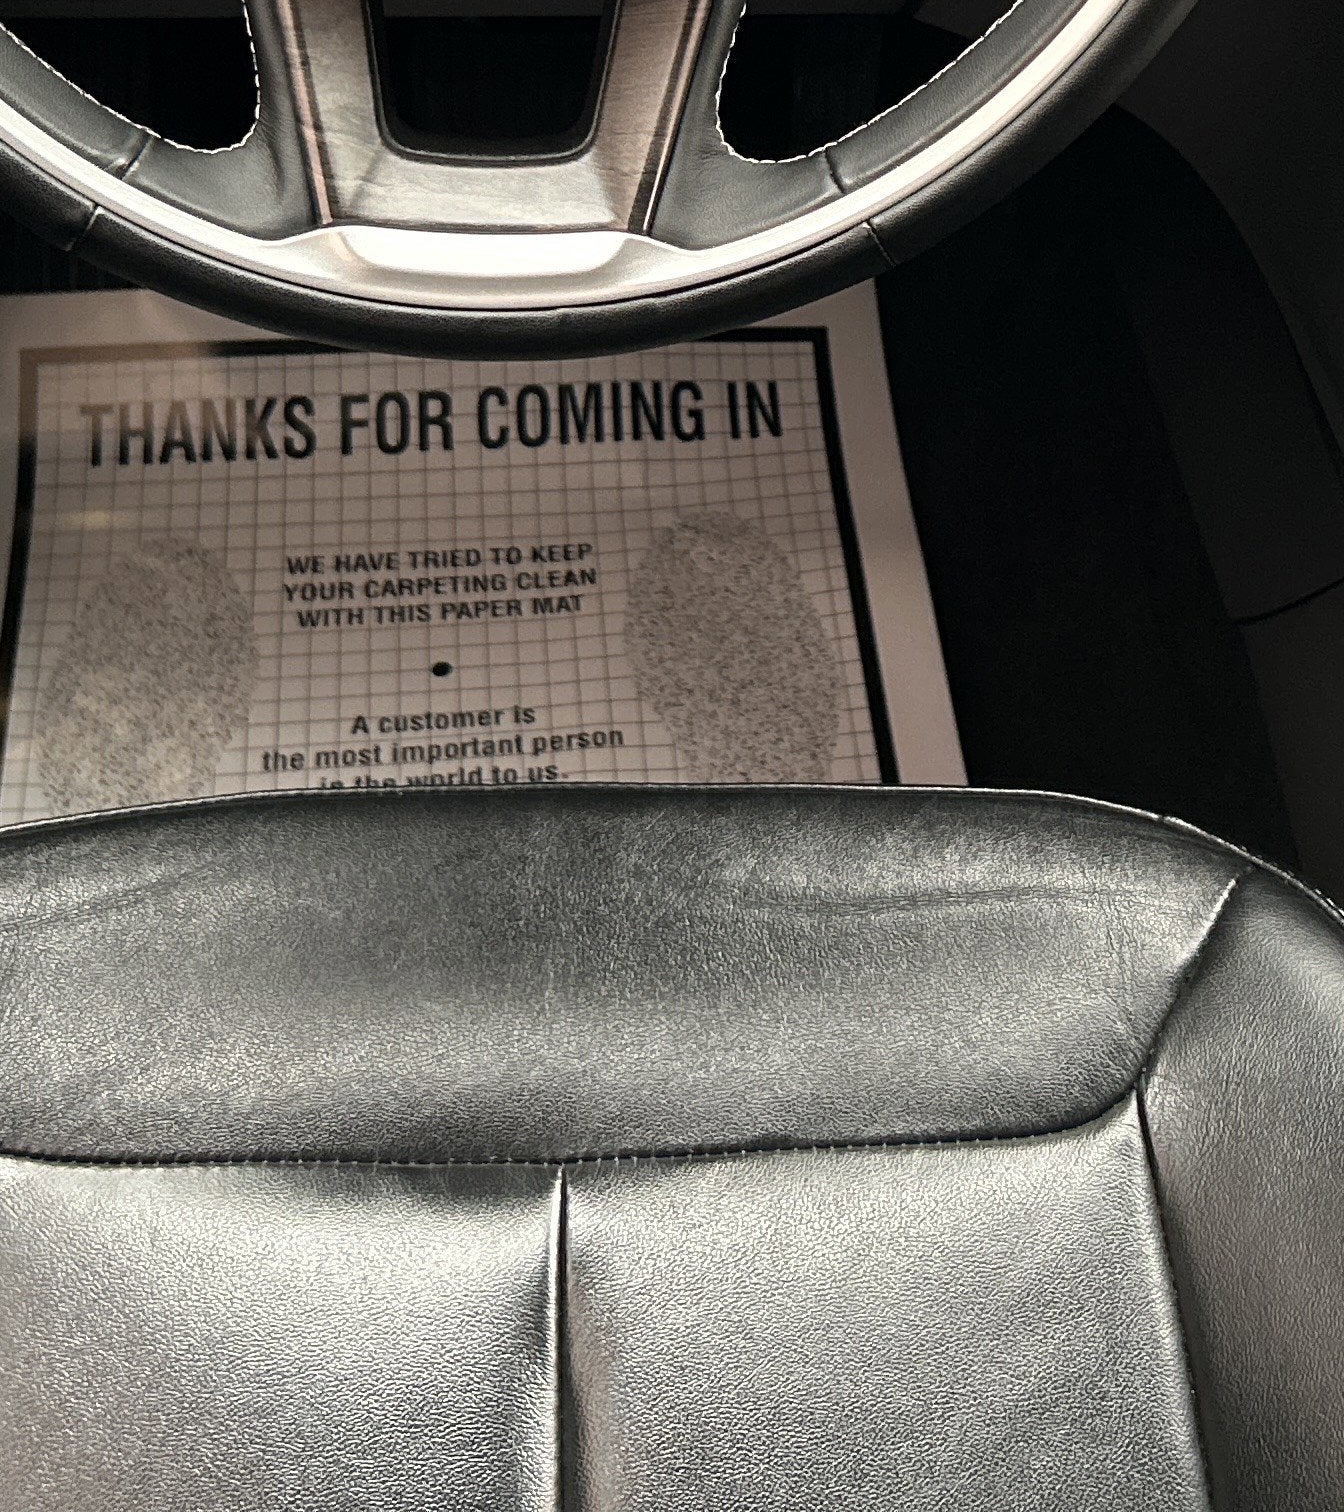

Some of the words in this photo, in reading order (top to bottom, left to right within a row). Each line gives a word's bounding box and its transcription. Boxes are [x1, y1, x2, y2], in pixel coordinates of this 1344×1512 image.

[79, 395, 318, 468] THANKS
[340, 389, 455, 457] FOR
[476, 381, 706, 450] COMING
[726, 379, 784, 440] IN
[287, 555, 328, 575] WE
[334, 551, 401, 573] HAVE
[408, 548, 483, 570] TRIED
[490, 546, 523, 565] TO
[531, 543, 594, 564] KEEP
[282, 581, 355, 603] YOUR
[364, 574, 506, 600] CARPETING
[516, 568, 597, 591] CLEAN
[297, 608, 365, 629] WITH
[374, 603, 431, 625] THIS
[441, 598, 522, 622] PAPER
[532, 595, 585, 615] MAT
[350, 715, 370, 735] A
[378, 708, 502, 734] customer
[513, 705, 535, 725] is
[262, 750, 305, 772] the
[315, 743, 382, 769] most
[392, 734, 524, 765] important
[532, 728, 624, 756] person
[406, 766, 484, 787] world
[492, 764, 518, 784] to
